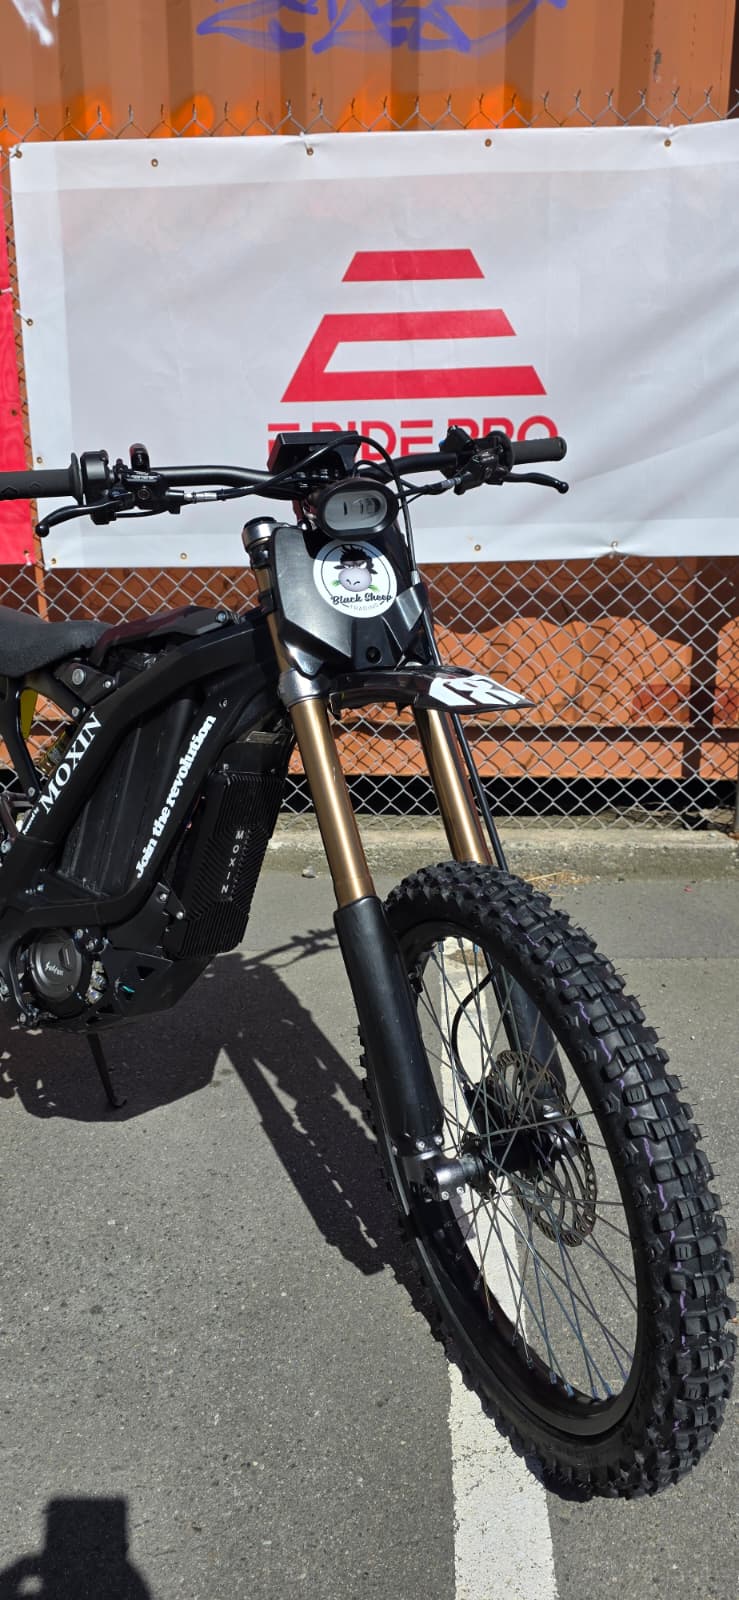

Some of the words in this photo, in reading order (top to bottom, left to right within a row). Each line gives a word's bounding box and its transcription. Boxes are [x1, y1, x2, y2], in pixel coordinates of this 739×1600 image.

[311, 420, 434, 462] DE
[331, 594, 362, 605] Black
[364, 592, 392, 602] Sheep
[38, 711, 102, 815] MOXIN
[135, 838, 159, 880] Join
[152, 805, 172, 837] the
[165, 715, 217, 808] revolution
[221, 830, 244, 894] MOXIN
